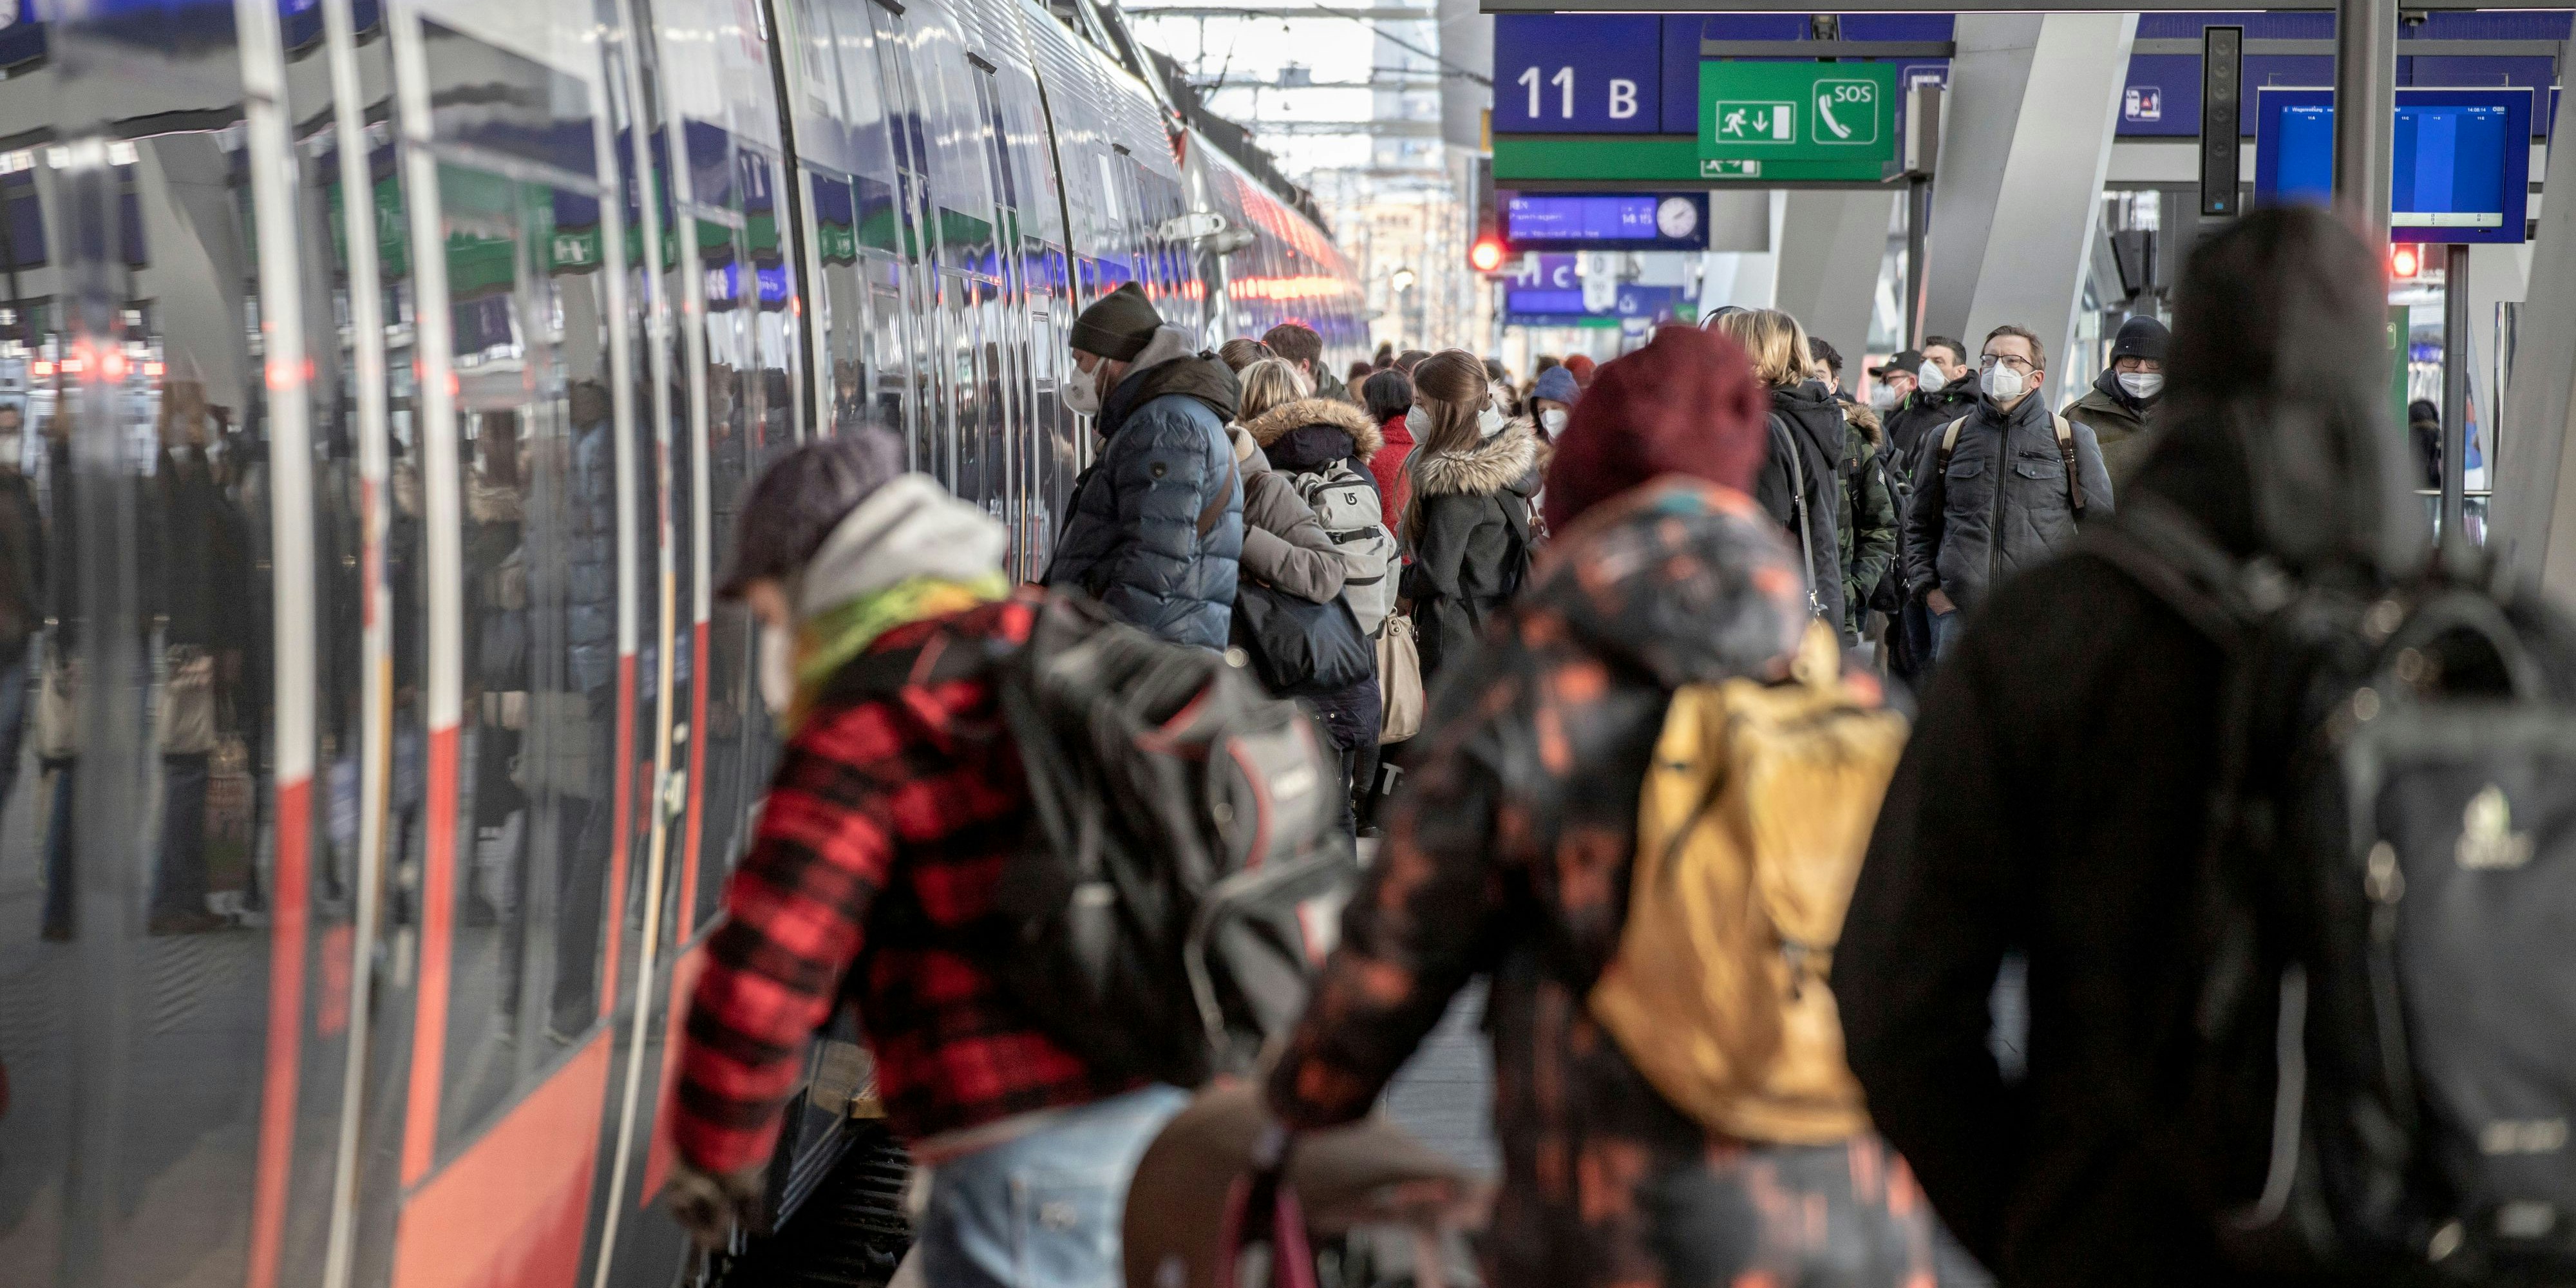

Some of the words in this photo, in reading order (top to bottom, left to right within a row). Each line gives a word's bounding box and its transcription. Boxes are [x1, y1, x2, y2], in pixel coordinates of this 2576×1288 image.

[1517, 66, 1573, 118] 11
[1609, 79, 1638, 118] B
[1835, 86, 1871, 102] SOS
